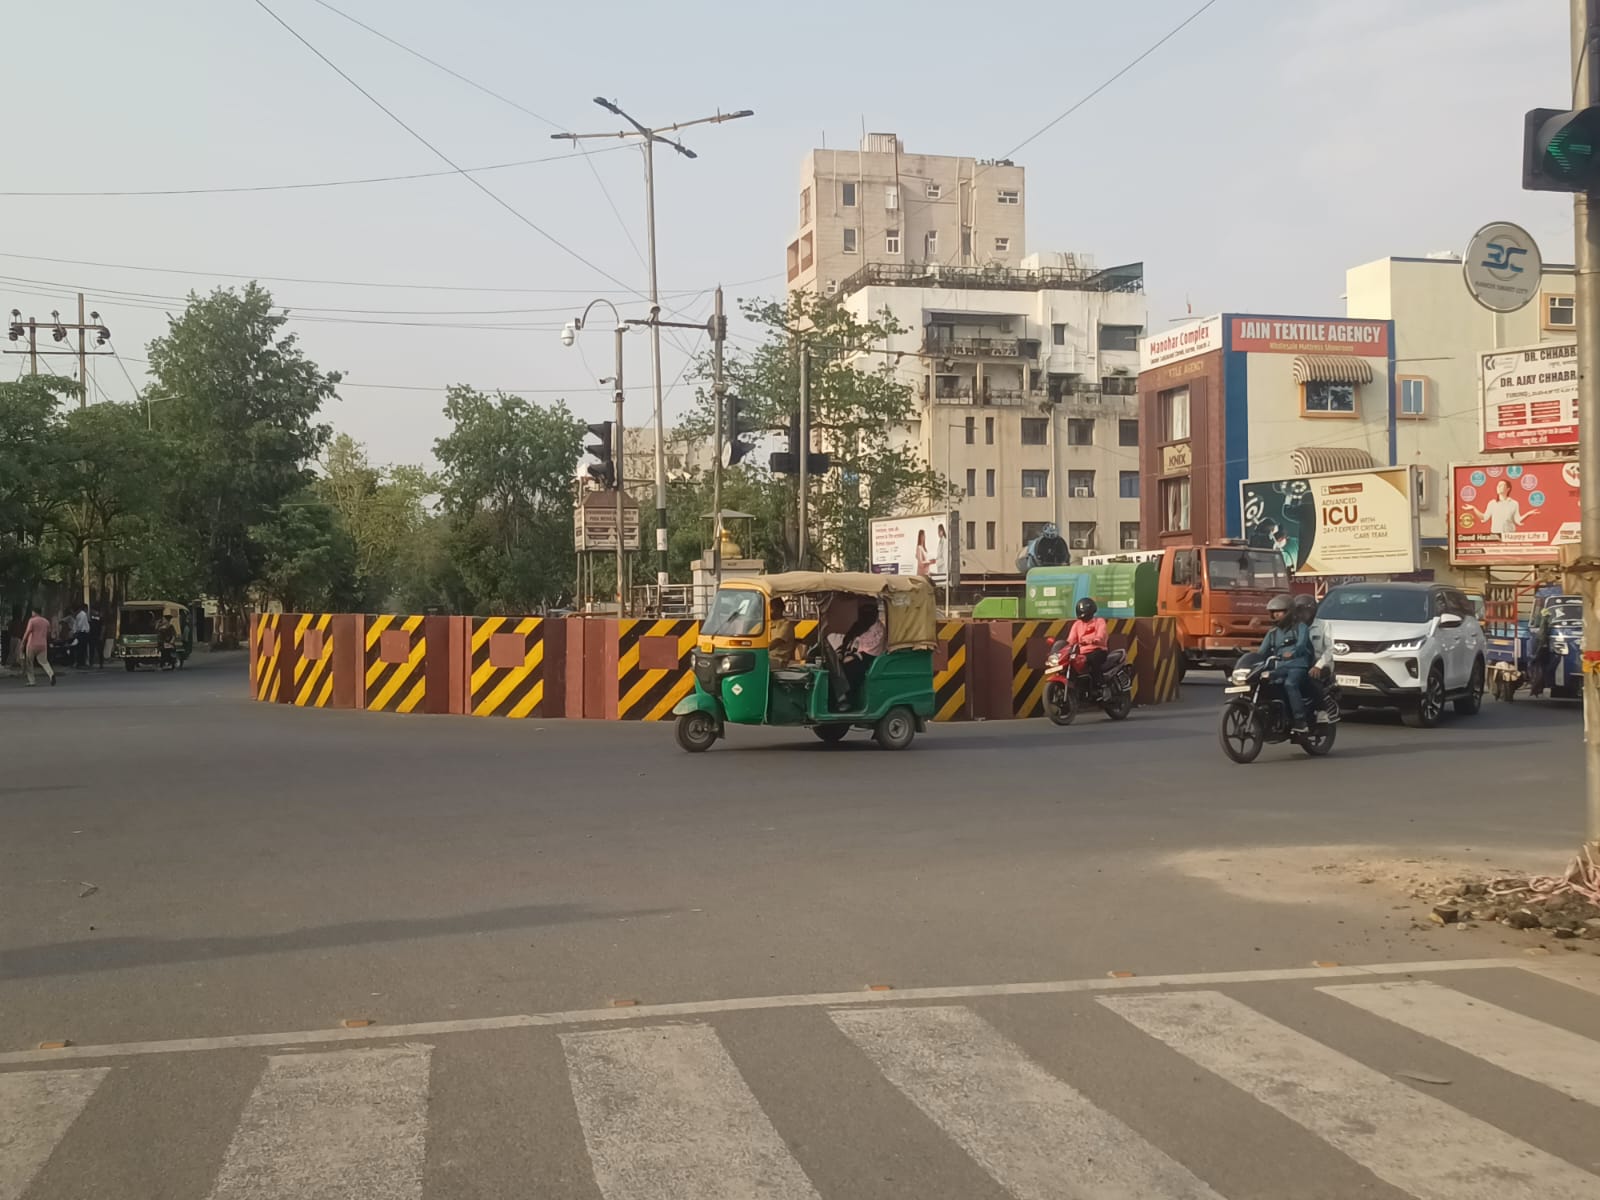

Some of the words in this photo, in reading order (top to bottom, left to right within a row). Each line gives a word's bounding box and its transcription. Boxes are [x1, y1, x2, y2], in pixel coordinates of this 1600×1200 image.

[1240, 321, 1270, 339] JAIN
[1273, 322, 1326, 341] TEXTILE
[1327, 324, 1381, 343] AGENCY
[1150, 335, 1179, 356] Manohar
[1179, 325, 1209, 345] Complex
[1524, 351, 1538, 362] DR.
[1540, 347, 1577, 361] CHHABR
[1500, 377, 1514, 388] DR.
[1516, 375, 1537, 386] AJAY
[1538, 370, 1577, 384] CHHABR
[1322, 497, 1357, 506] ADVANCED
[1322, 505, 1358, 526] ICU
[1338, 525, 1360, 533] EXPERT
[1360, 523, 1387, 532] CRITICAL
[1504, 533, 1526, 541] Happy
